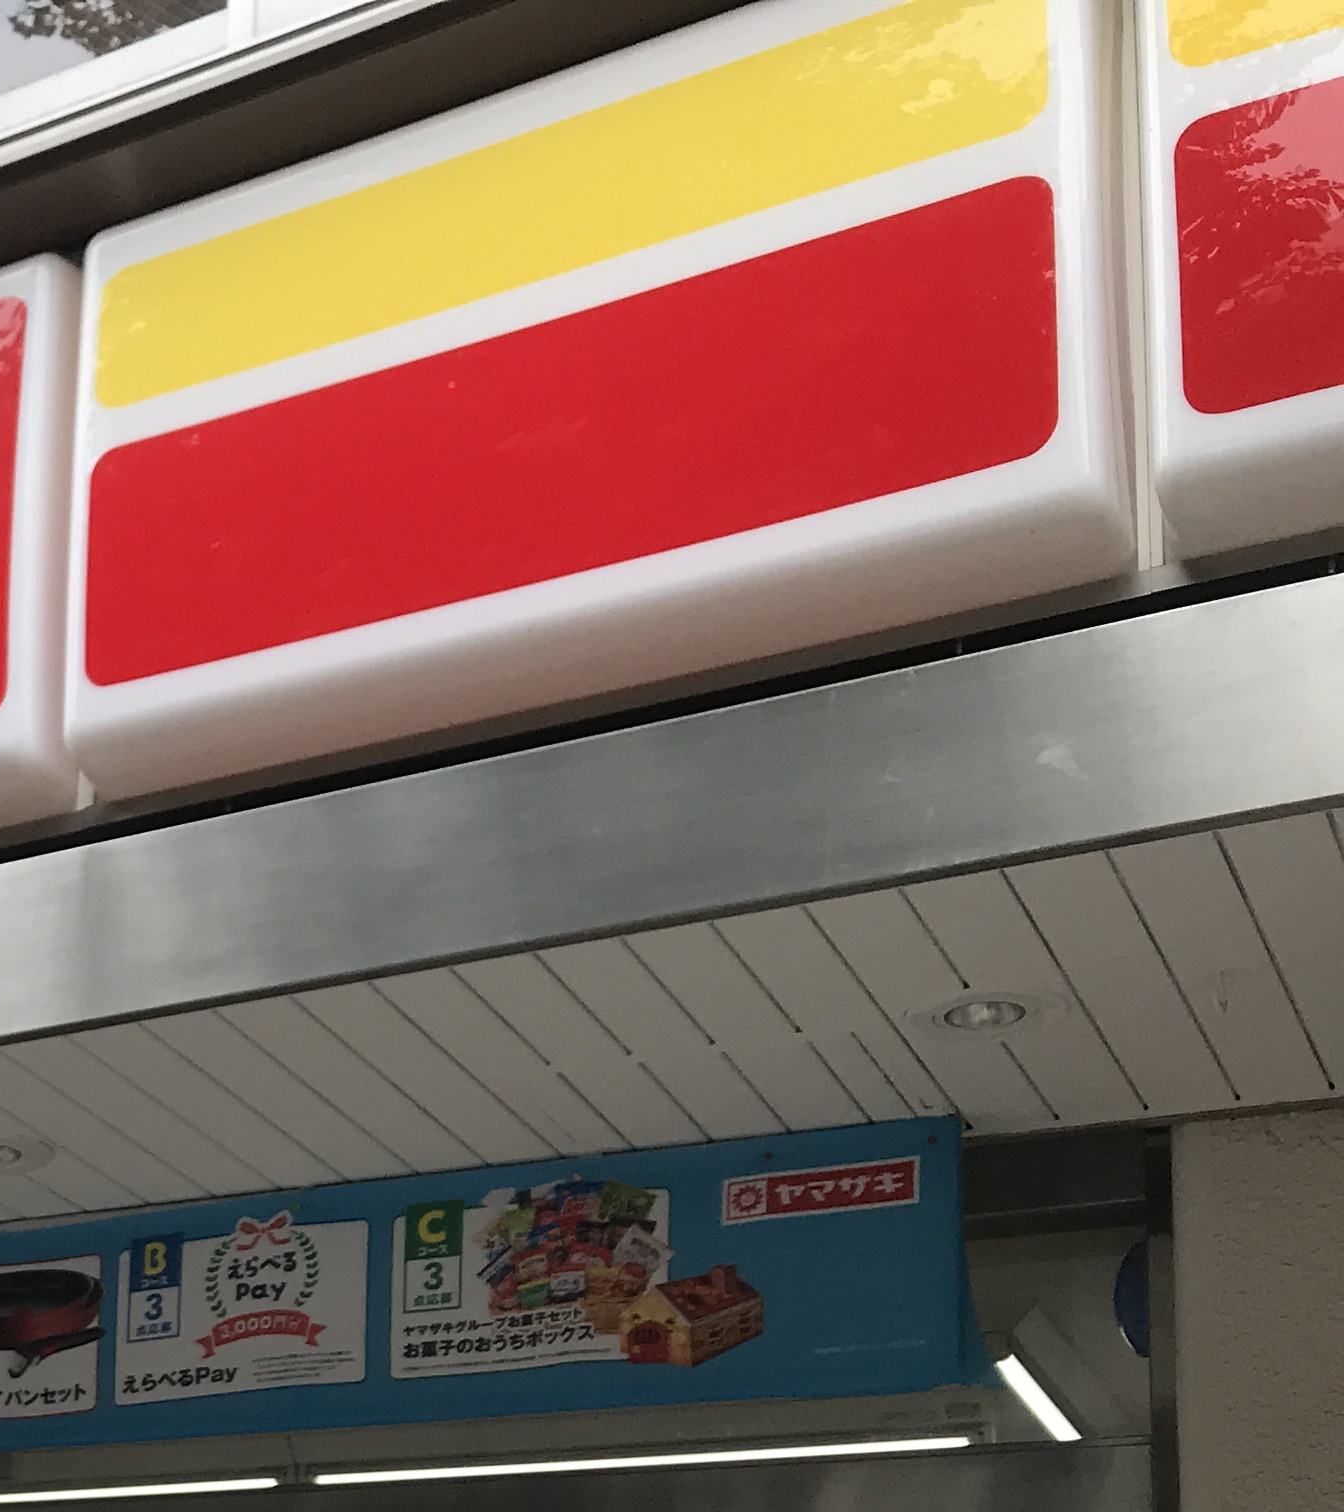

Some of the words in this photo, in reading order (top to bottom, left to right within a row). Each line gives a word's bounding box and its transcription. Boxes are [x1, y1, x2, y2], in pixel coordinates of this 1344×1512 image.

[774, 1167, 906, 1207] ヤマザキ
[417, 1209, 447, 1244] C
[144, 1242, 167, 1276] B
[227, 1251, 298, 1281] えらべる
[424, 1262, 444, 1290] 3
[144, 1292, 163, 1321] 3
[403, 1324, 596, 1360] お菓子のおうちボックス
[122, 1366, 239, 1394] えらべるPay
